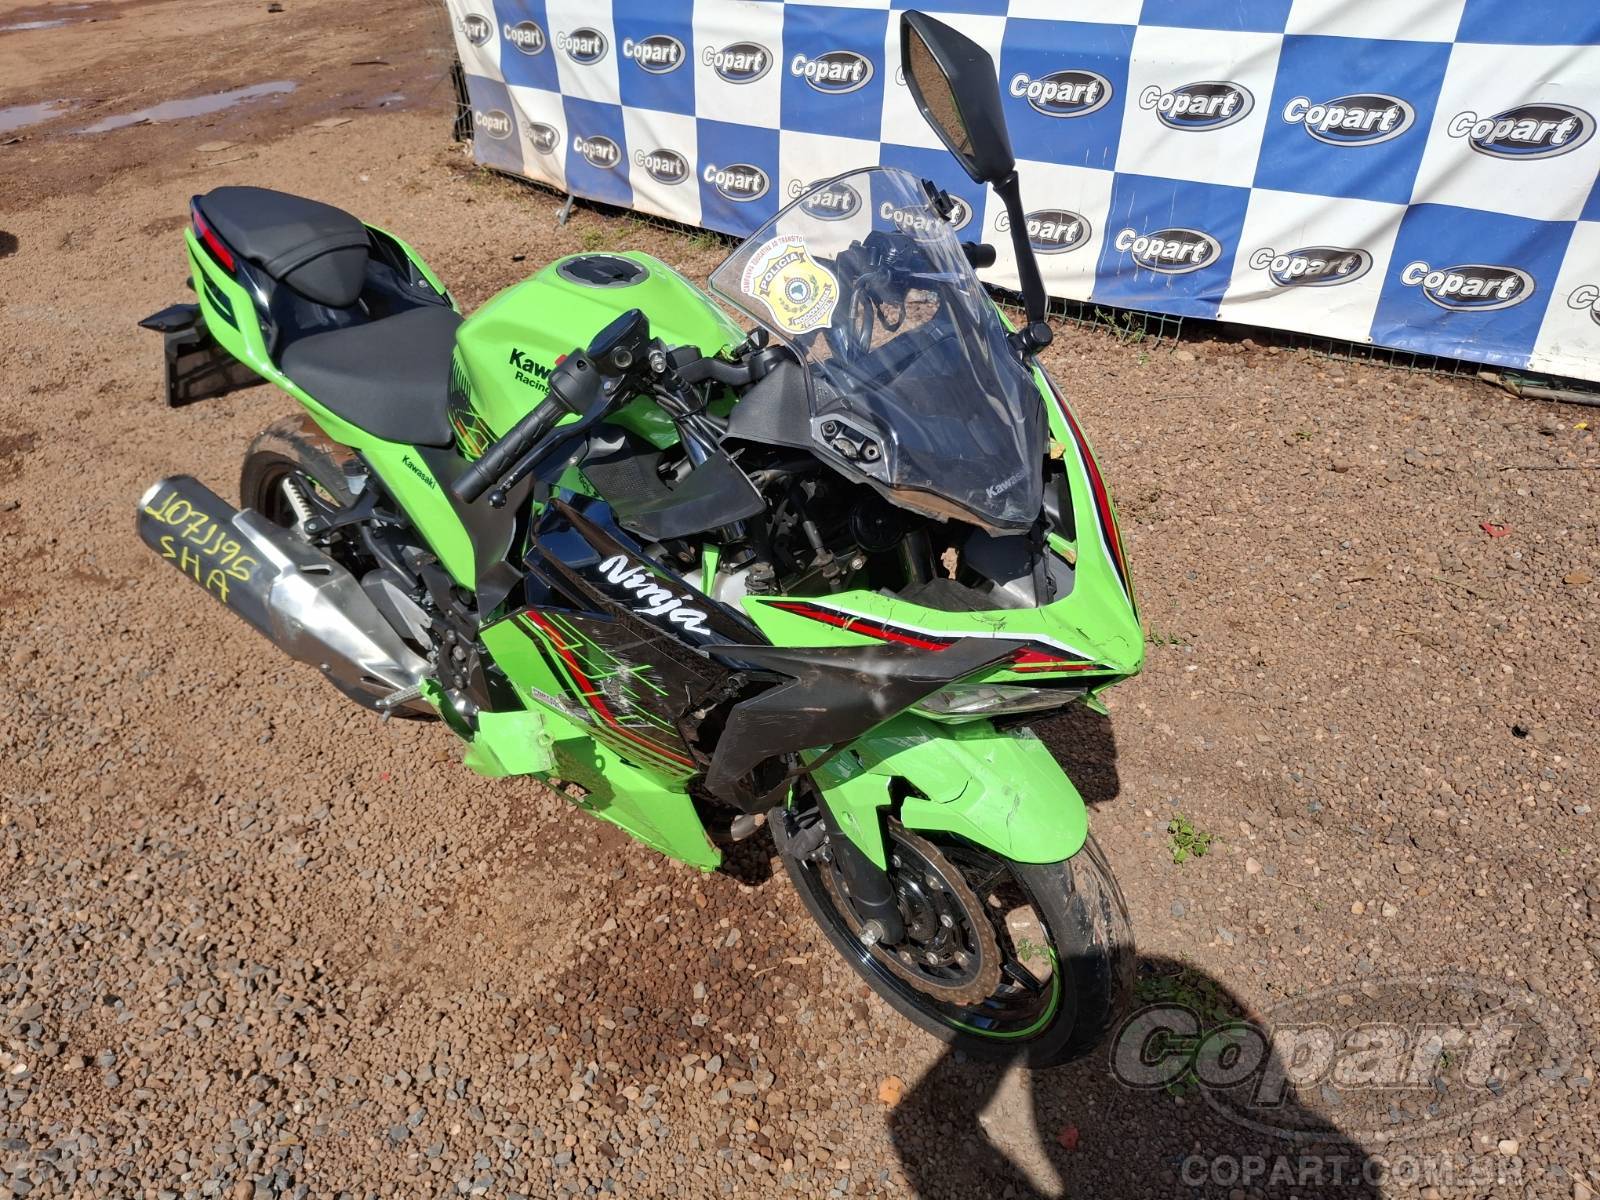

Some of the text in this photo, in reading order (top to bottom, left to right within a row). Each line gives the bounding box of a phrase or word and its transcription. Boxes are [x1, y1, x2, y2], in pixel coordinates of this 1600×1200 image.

[503, 24, 541, 47] Copart
[556, 31, 601, 54] Copart
[623, 40, 678, 63] Copart
[702, 46, 763, 72] Copart
[791, 54, 863, 82] Copart
[1009, 73, 1099, 105] Copart
[1139, 85, 1239, 119] Copart
[475, 111, 509, 133] Copart
[1283, 96, 1402, 132] Copart
[1448, 111, 1577, 145] Copart
[573, 137, 615, 161] Copart
[635, 149, 682, 175] Copart
[703, 164, 761, 192] Copart
[995, 209, 1081, 243] Cpart
[1114, 228, 1208, 263] Copart
[1249, 247, 1358, 280] Copart
[1400, 261, 1520, 299] Copart
[402, 455, 436, 490] Kawasaki
[160, 536, 230, 603] SHA
[599, 554, 711, 635] Ninja
